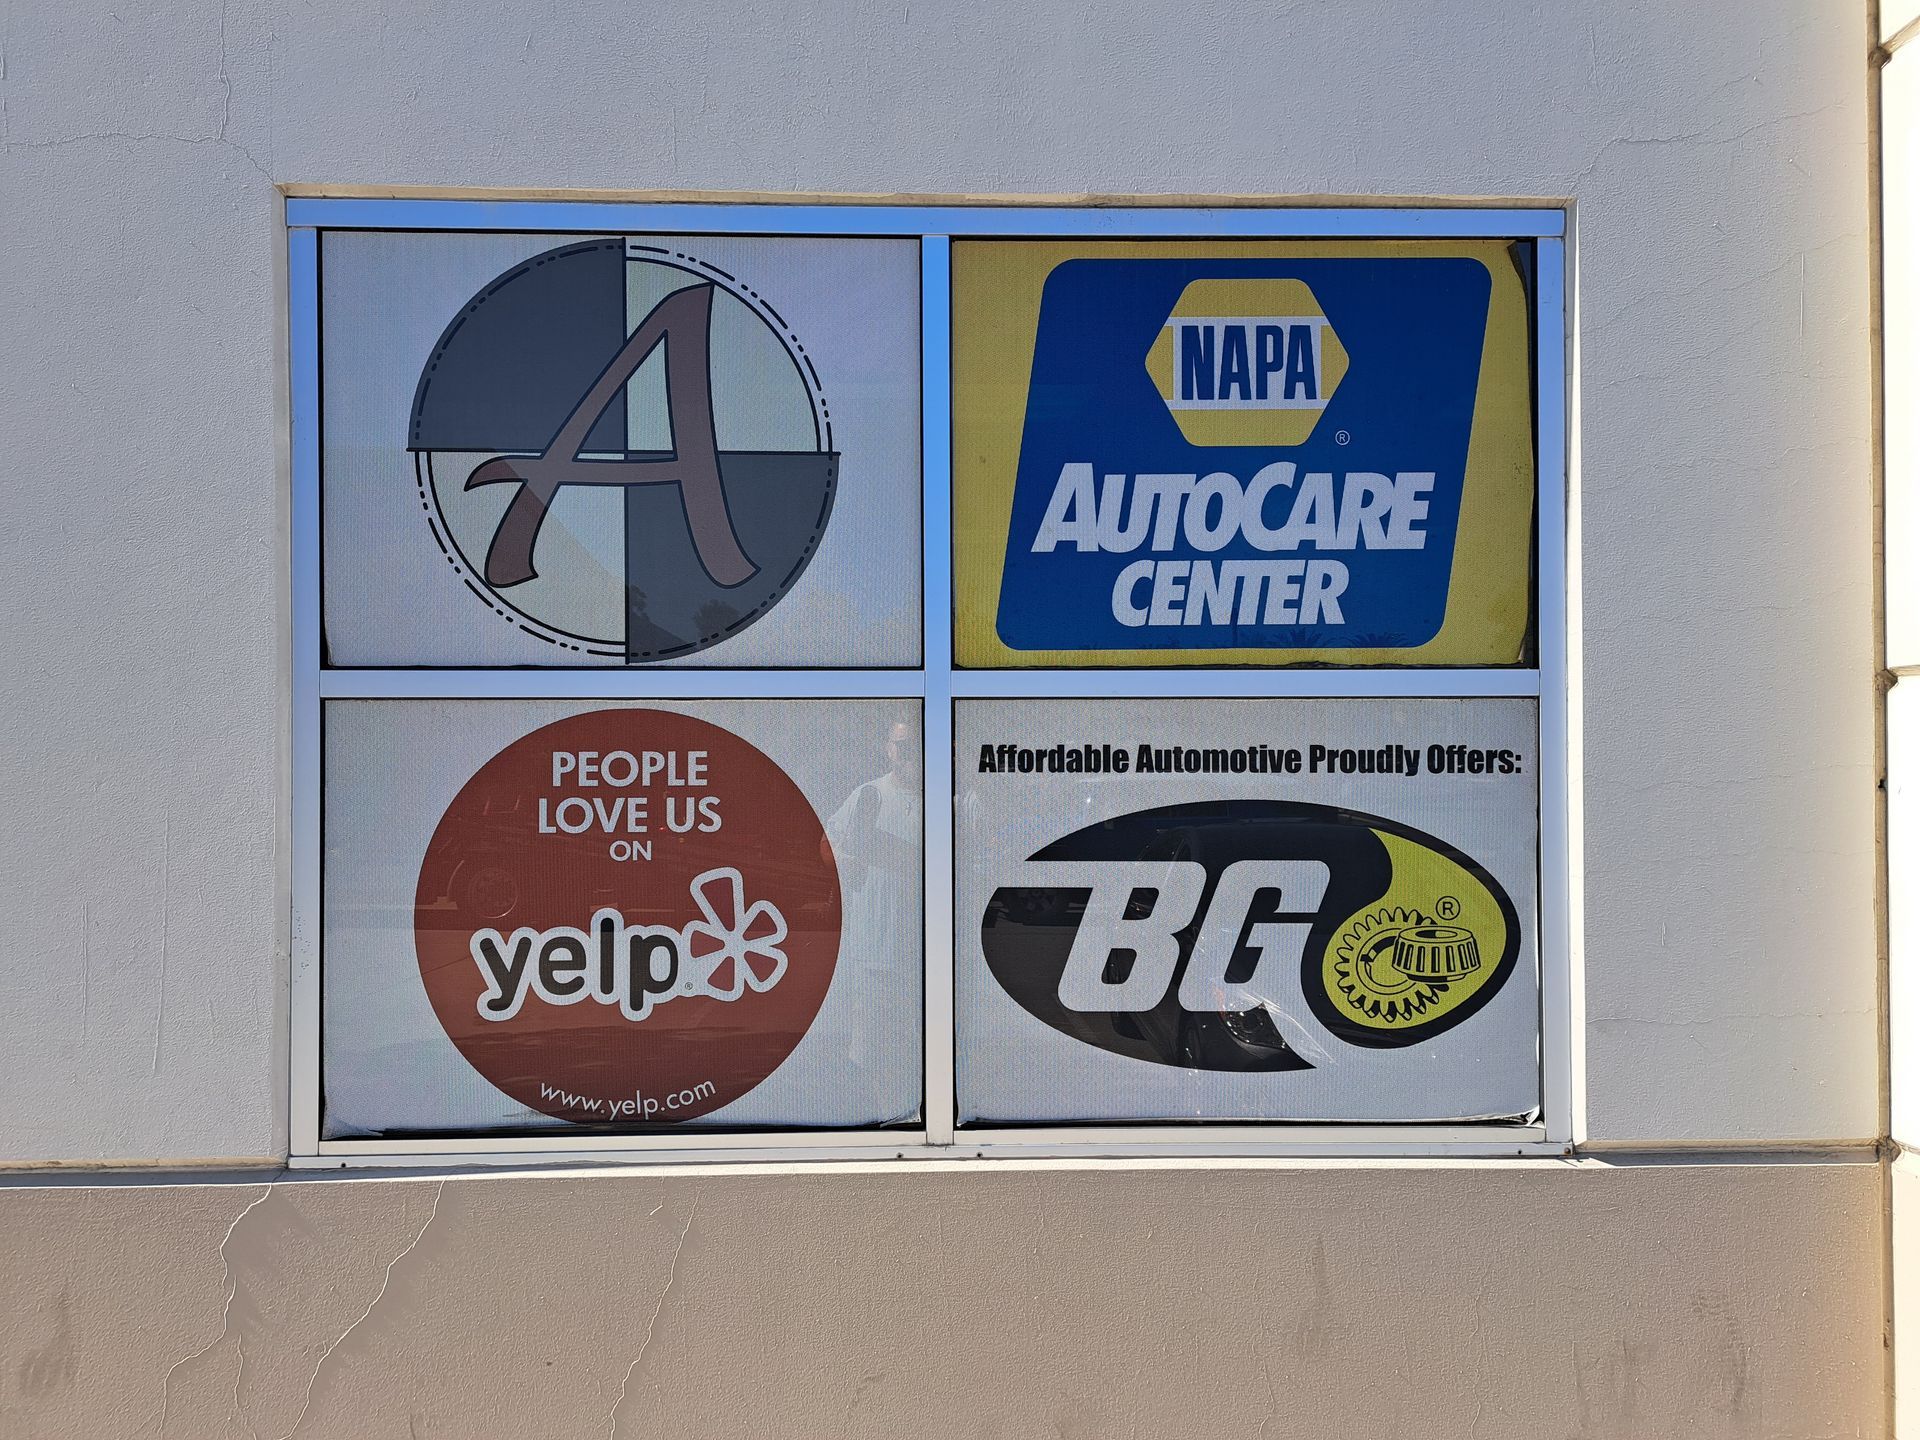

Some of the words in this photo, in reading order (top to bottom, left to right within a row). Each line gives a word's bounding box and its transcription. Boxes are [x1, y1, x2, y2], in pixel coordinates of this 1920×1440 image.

[1181, 325, 1318, 400] NAPA
[1111, 559, 1350, 627] CENTER
[552, 750, 708, 787] PEOPLE
[978, 744, 1129, 774] Affordable
[1136, 744, 1302, 774] Automotive
[1309, 744, 1419, 777] Proudly
[1427, 744, 1523, 775] Offers:
[538, 798, 648, 834] LOVE
[666, 797, 722, 833] US
[609, 840, 652, 862] ON
[1057, 860, 1331, 1012] BG
[478, 917, 680, 1012] yelp
[540, 1079, 716, 1121] www.yelp.com
